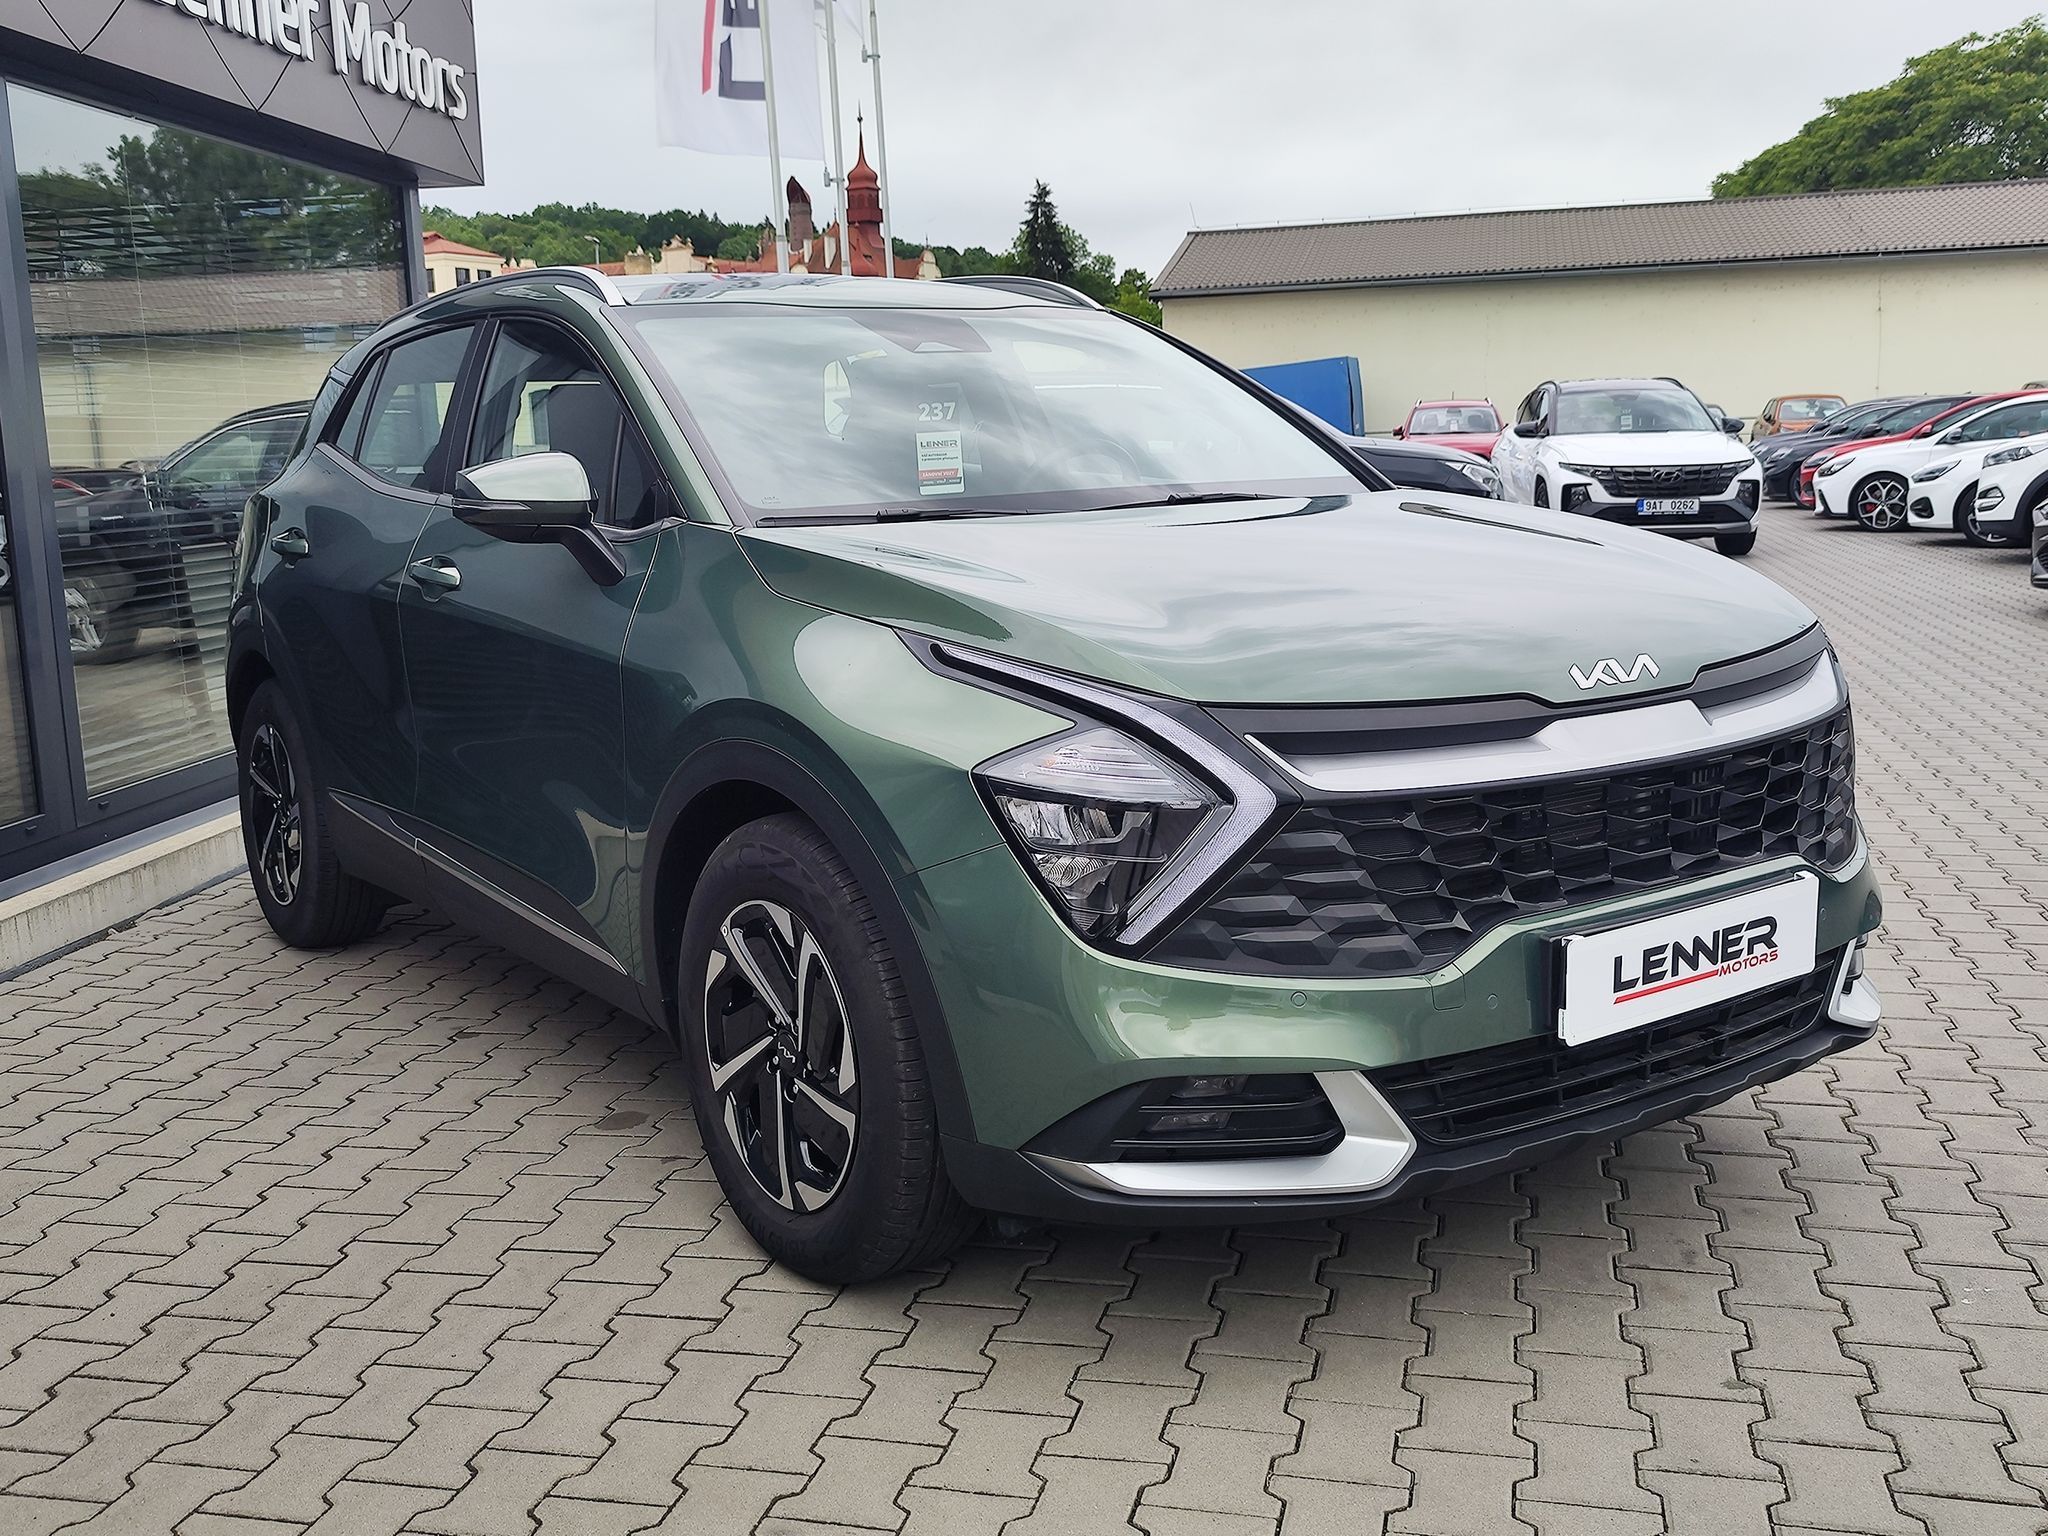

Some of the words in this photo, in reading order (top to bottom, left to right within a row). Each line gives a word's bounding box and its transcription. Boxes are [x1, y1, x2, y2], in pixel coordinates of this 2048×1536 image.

[330, 0, 468, 120] Motors
[918, 402, 956, 421] 237
[920, 439, 958, 448] LENNER
[1645, 500, 1664, 511] 9AT
[1670, 500, 1695, 510] 0262
[1568, 653, 1660, 690] KIA
[1613, 915, 1778, 994] LENNER
[1718, 950, 1779, 977] MOTORS
